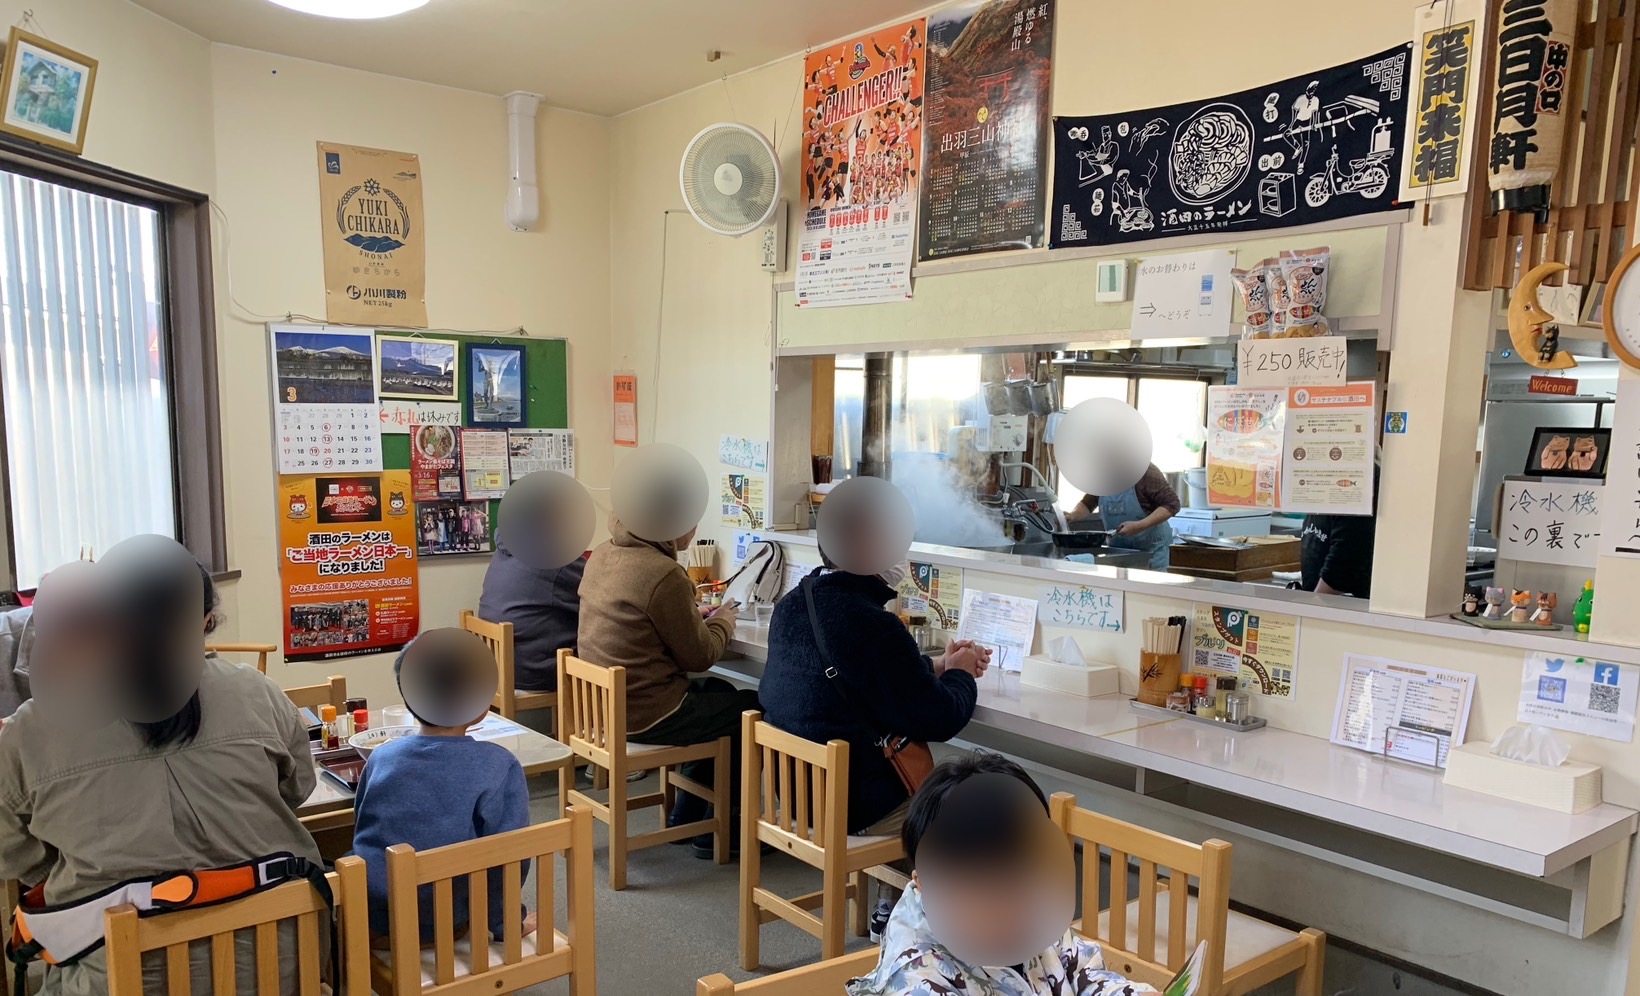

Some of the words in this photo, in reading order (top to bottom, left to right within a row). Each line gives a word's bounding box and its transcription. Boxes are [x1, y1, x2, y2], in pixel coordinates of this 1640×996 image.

[1011, 11, 1024, 51] 湯殿山
[823, 66, 903, 127] CHALLENGER!!
[1490, 0, 1552, 174] 三日月軒
[1414, 26, 1470, 182] 笑門来福
[1261, 154, 1283, 168] 出前
[358, 198, 388, 217] YUKI
[1161, 199, 1252, 226] 酒田のラーメン
[347, 215, 400, 235] CHIKARA
[359, 250, 393, 260] SHONAI
[364, 288, 407, 299] 小川製粉
[1158, 309, 1191, 320] へどうぞ
[287, 386, 297, 402] 3
[1532, 379, 1572, 393] Welcome
[1509, 489, 1598, 515] 冷水機
[309, 532, 391, 545] 酒田のラーメンは
[1509, 519, 1600, 549] この裏で
[287, 547, 412, 562] 「ご当地ラーメン日本一」
[1047, 586, 1114, 610] 冷水機は
[1052, 608, 1109, 630] こちらです
[1214, 611, 1239, 644] スタンプゲット
[1243, 657, 1269, 694] 今すぐダウンロード
